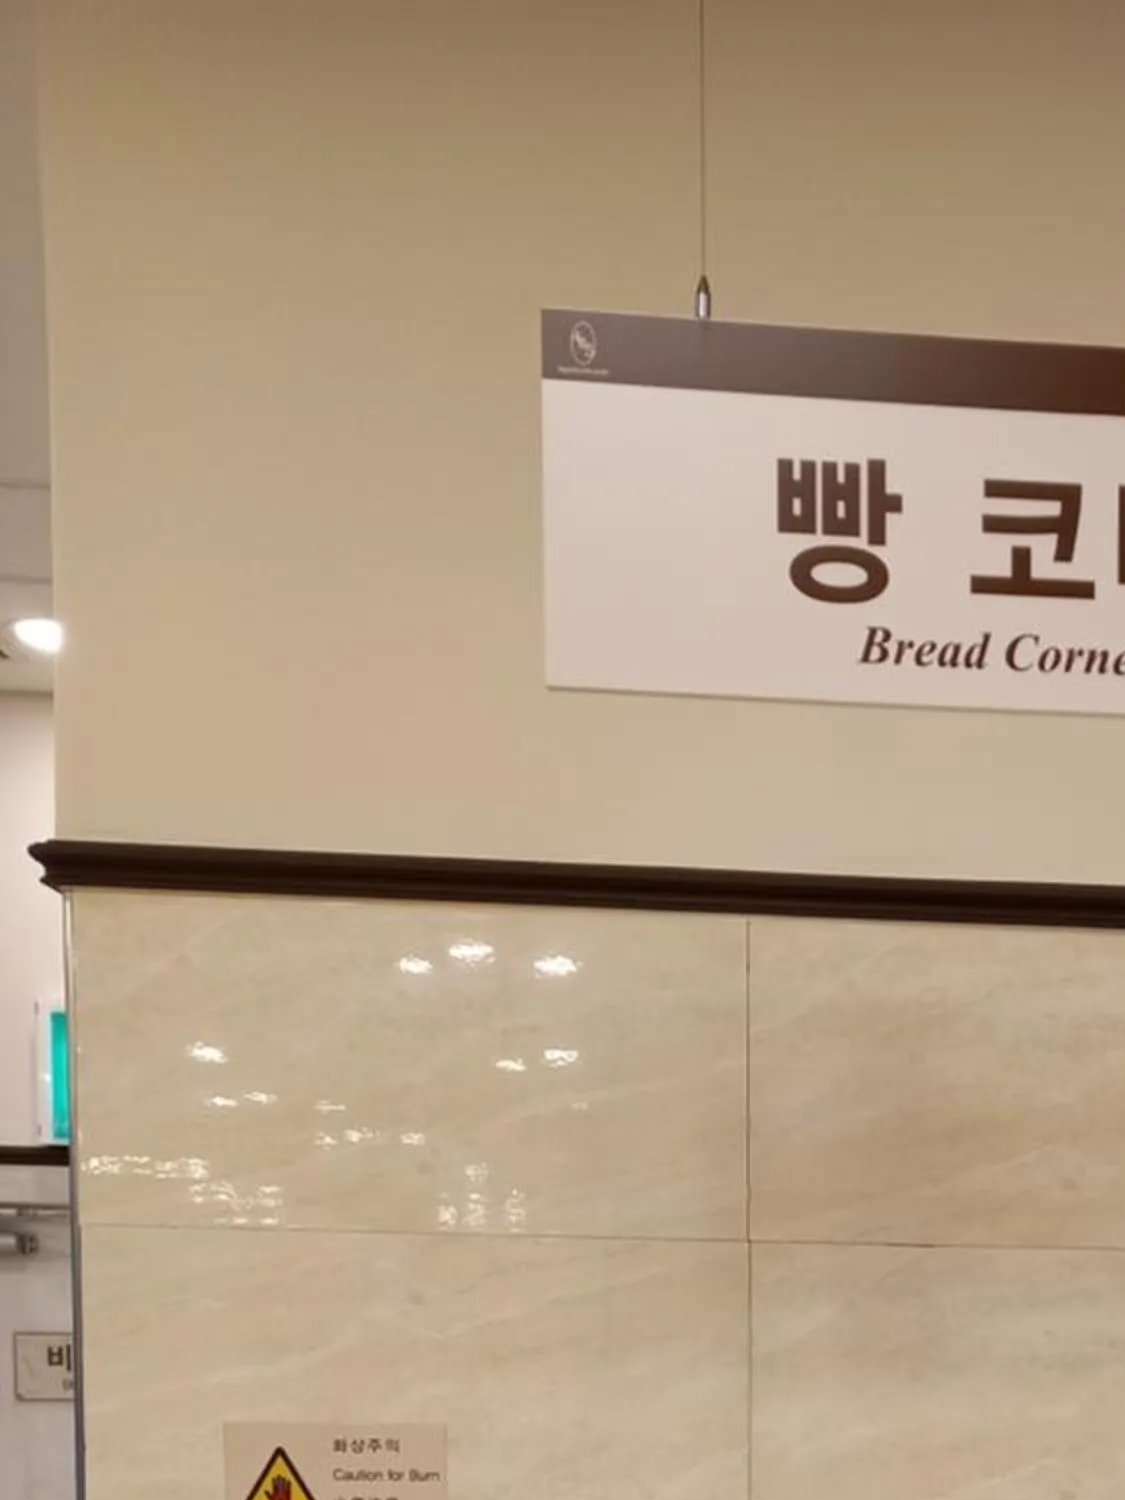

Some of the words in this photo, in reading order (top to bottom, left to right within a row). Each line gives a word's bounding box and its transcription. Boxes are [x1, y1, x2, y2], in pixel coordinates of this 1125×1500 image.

[776, 457, 903, 604] 빵
[859, 626, 990, 672] Bread
[332, 1468, 383, 1482] Caution
[387, 1468, 405, 1482] for
[409, 1468, 441, 1482] Burn
